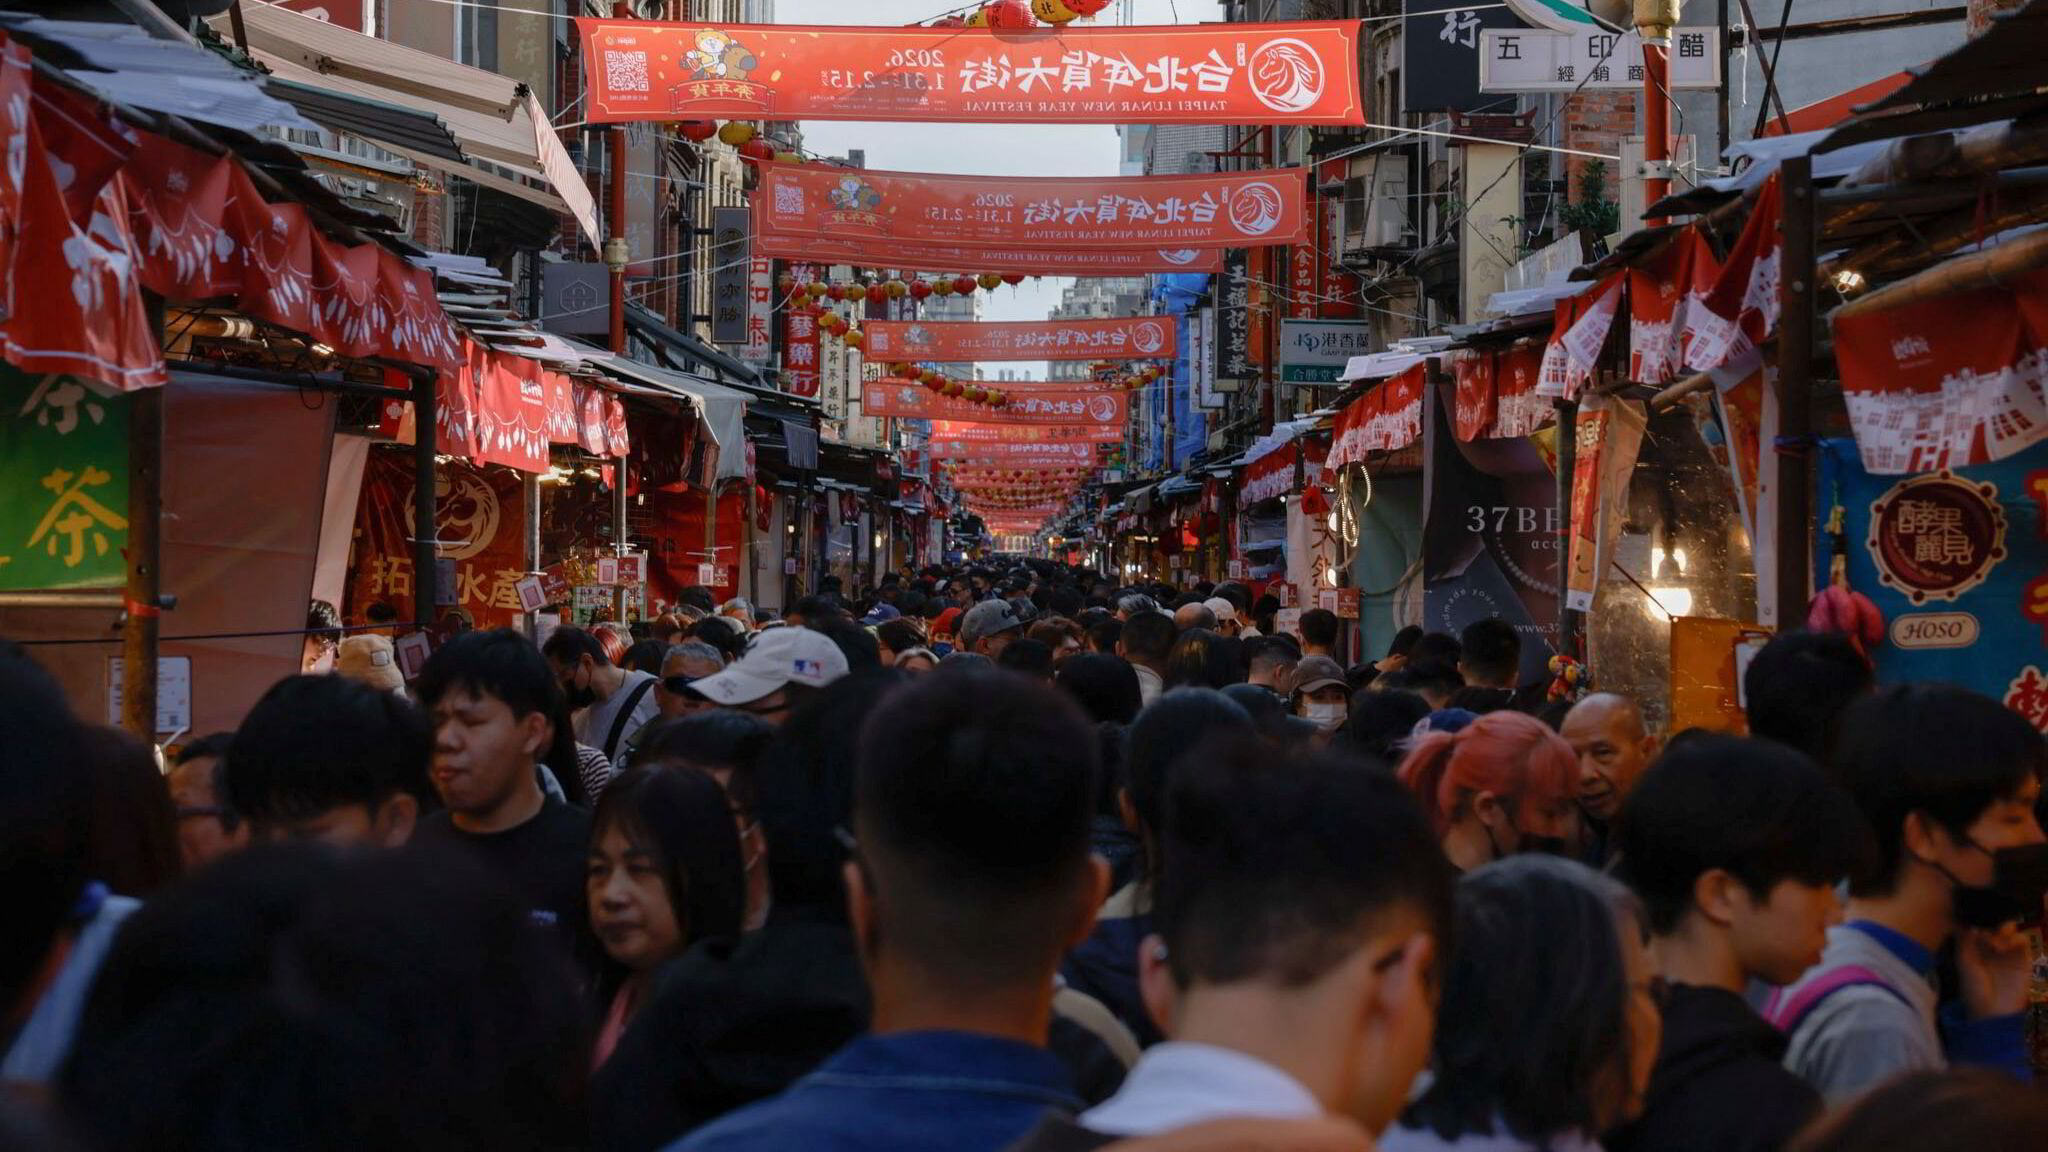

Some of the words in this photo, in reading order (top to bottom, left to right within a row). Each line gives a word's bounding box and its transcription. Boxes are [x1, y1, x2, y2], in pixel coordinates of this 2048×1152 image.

[1440, 10, 1482, 49] 行
[1497, 33, 1705, 60] 五印醋
[1557, 65, 1646, 83] 經銷商
[27, 465, 129, 567] 茶
[371, 552, 524, 609] 拓水產
[1902, 622, 1963, 640] HOSO
